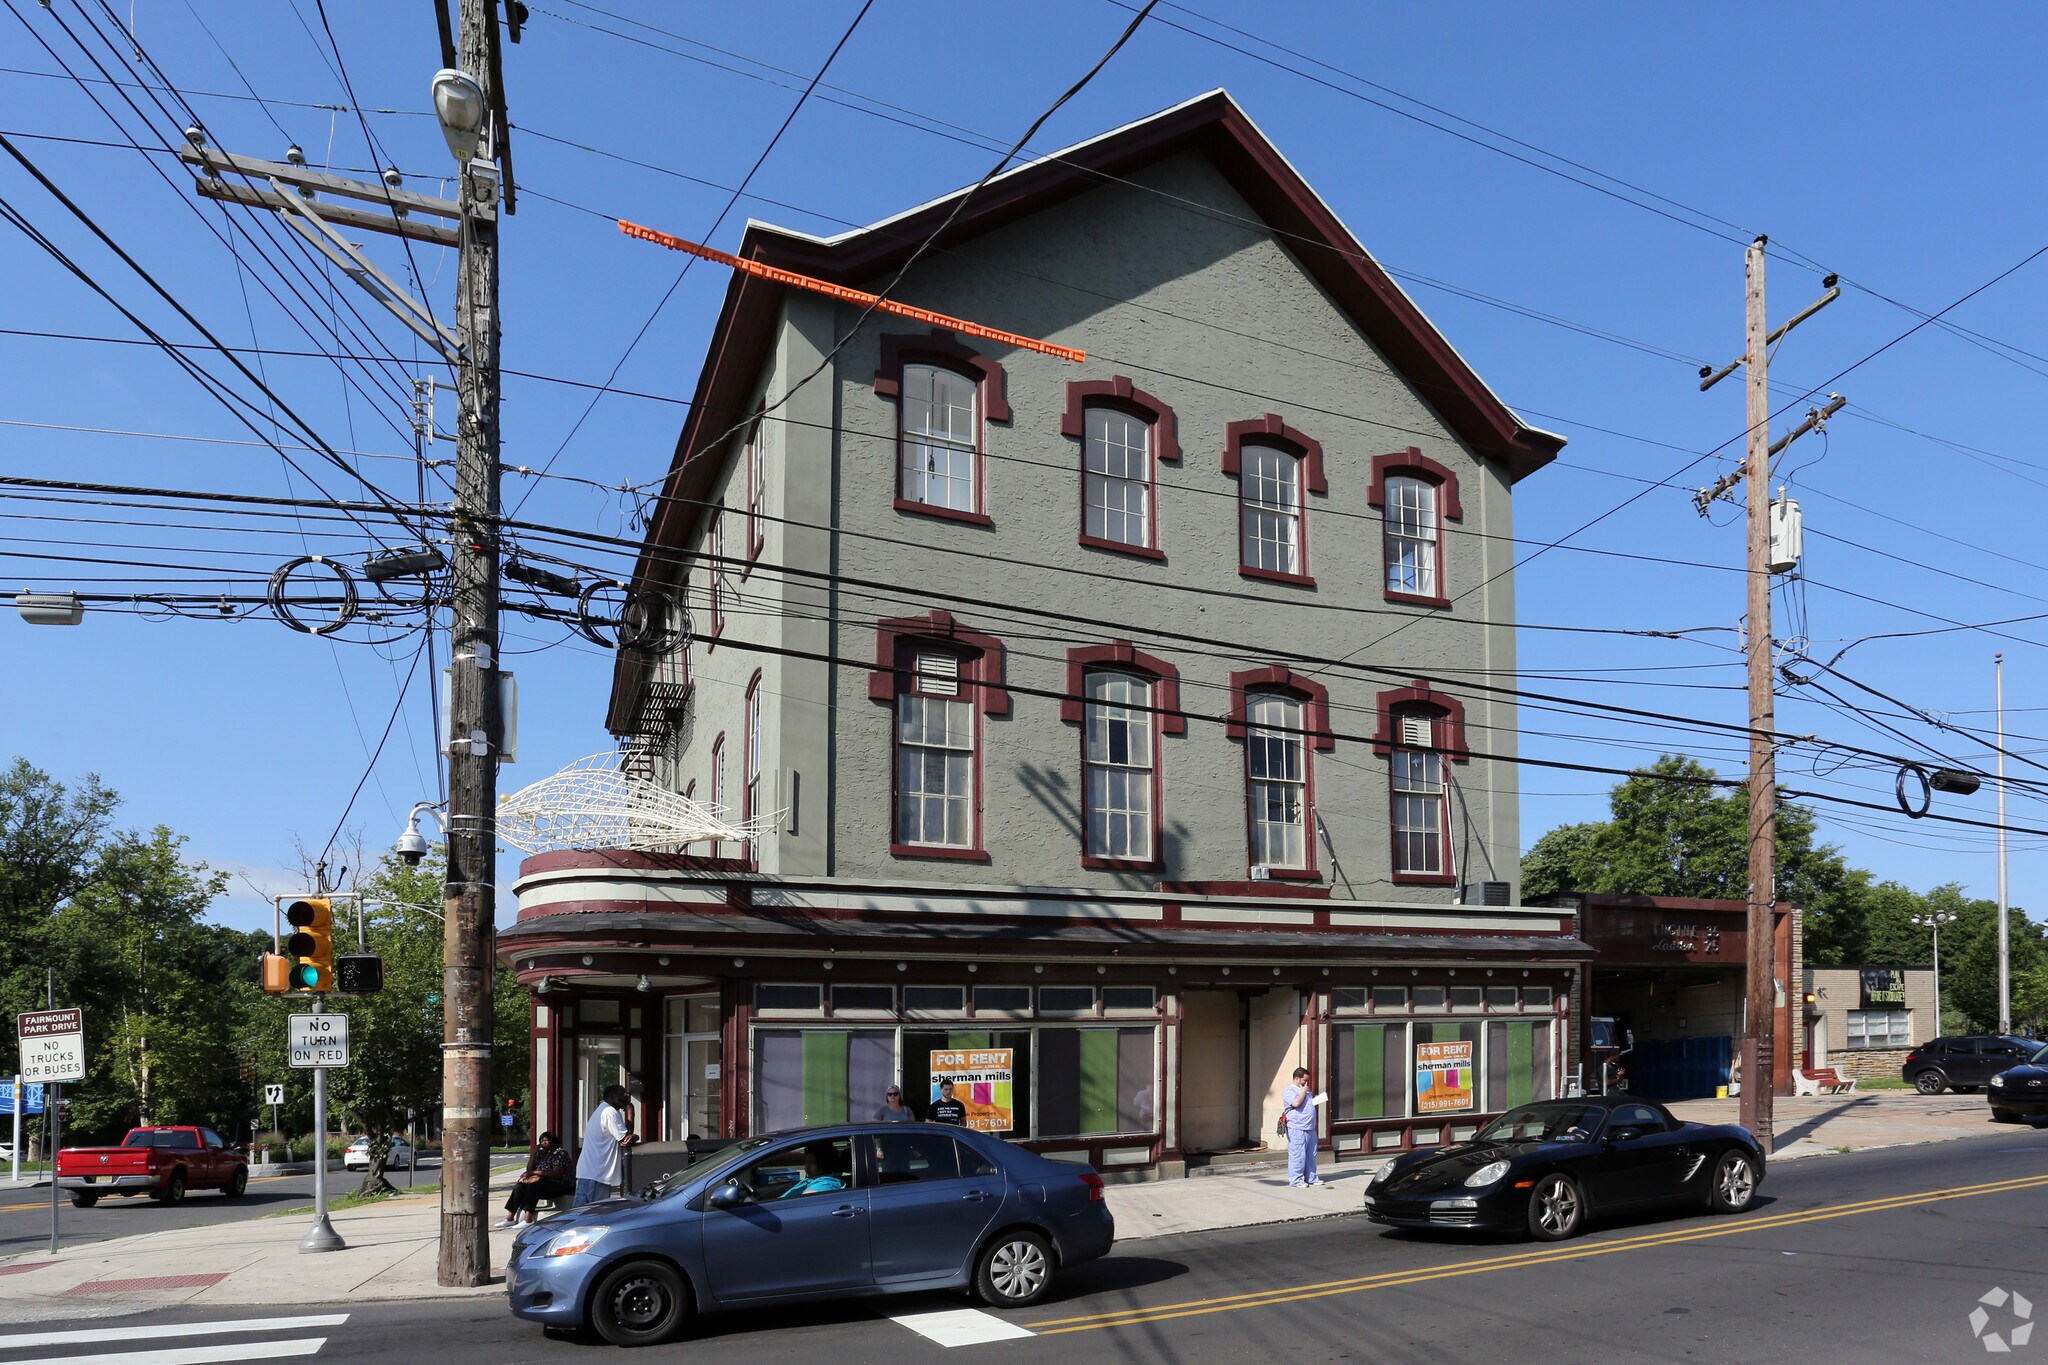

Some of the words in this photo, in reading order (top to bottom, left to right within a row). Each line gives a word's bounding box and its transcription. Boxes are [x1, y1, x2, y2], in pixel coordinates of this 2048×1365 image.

[1653, 923, 1698, 937] ENGINE
[25, 1013, 76, 1025] FAIRMOUNT
[24, 1025, 49, 1034] PARK
[51, 1021, 78, 1031] DRIVE
[309, 1021, 331, 1031] NO
[43, 1041, 59, 1051] NO
[301, 1035, 337, 1046] TURN
[294, 1050, 311, 1060] ON
[318, 1050, 343, 1060] RED
[1421, 1046, 1440, 1056] FOR
[1443, 1044, 1468, 1055] RENT
[30, 1051, 74, 1064] TRUCKS
[936, 1053, 965, 1066] FOR
[969, 1052, 1008, 1065] RENT
[24, 1067, 39, 1077] OR
[44, 1063, 81, 1075] BUSES
[1418, 1062, 1452, 1071] sherman
[1453, 1060, 1471, 1068] mills
[931, 1074, 982, 1083] sherman
[985, 1071, 1011, 1081] mills
[1421, 1100, 1438, 1110] (215)
[1439, 1098, 1469, 1108] 991-7601
